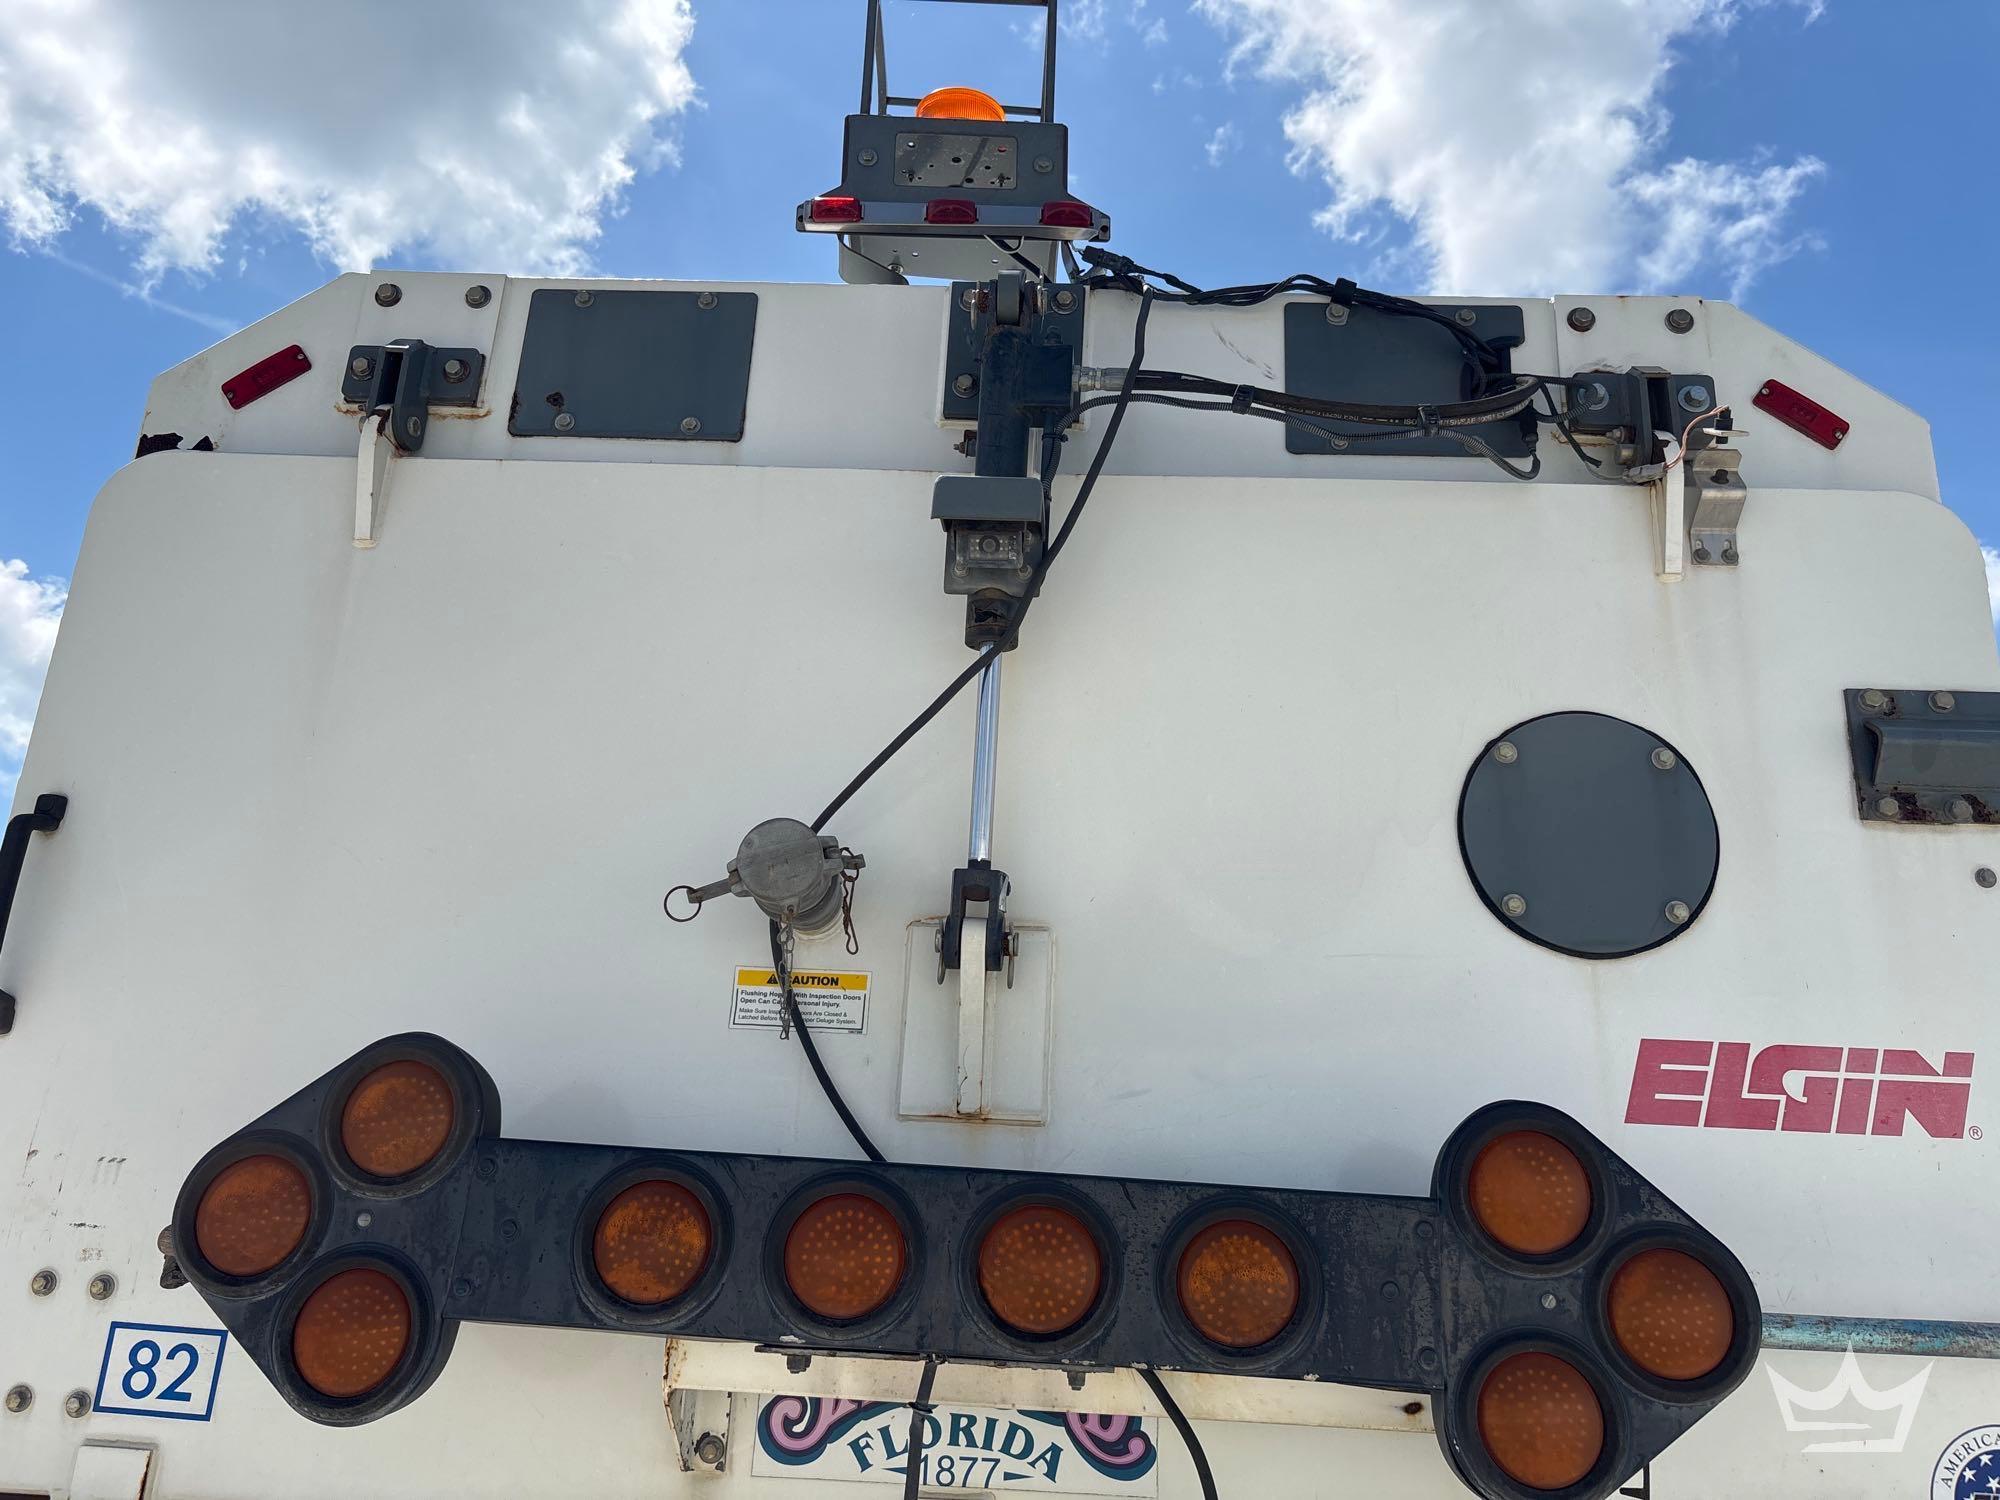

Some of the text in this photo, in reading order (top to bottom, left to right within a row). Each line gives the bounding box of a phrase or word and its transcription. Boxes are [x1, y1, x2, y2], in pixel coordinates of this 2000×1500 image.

[740, 989, 768, 998] Flushing
[789, 975, 839, 986] AUTION
[740, 997, 757, 1005] Open
[1624, 1038, 1975, 1140] ELGIN
[121, 1339, 200, 1402] 82
[846, 1412, 1065, 1484] FLORIDA
[920, 1453, 1001, 1489] 1877
